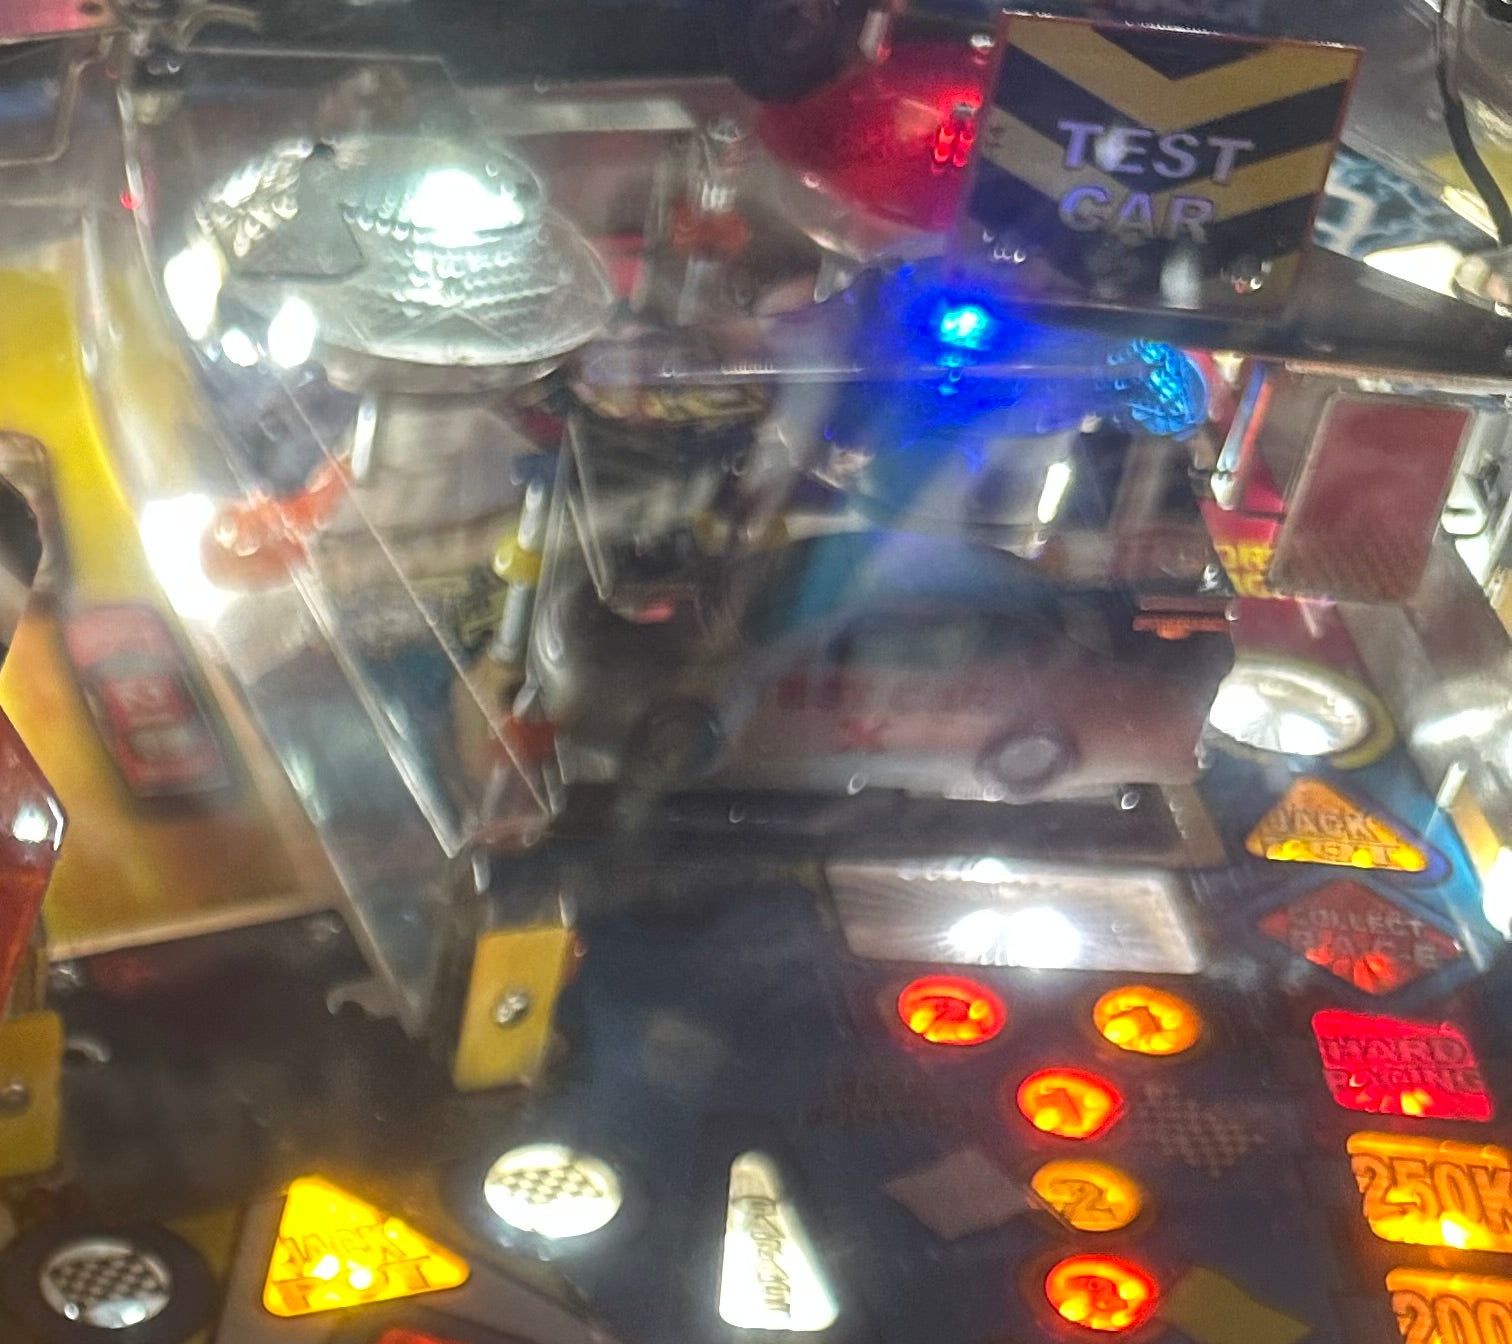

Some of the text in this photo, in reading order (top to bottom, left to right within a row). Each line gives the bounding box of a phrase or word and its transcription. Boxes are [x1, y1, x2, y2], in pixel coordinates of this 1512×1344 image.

[1057, 120, 1255, 186] TEST
[1058, 185, 1215, 245] CAR
[1321, 1038, 1468, 1069] HARD
